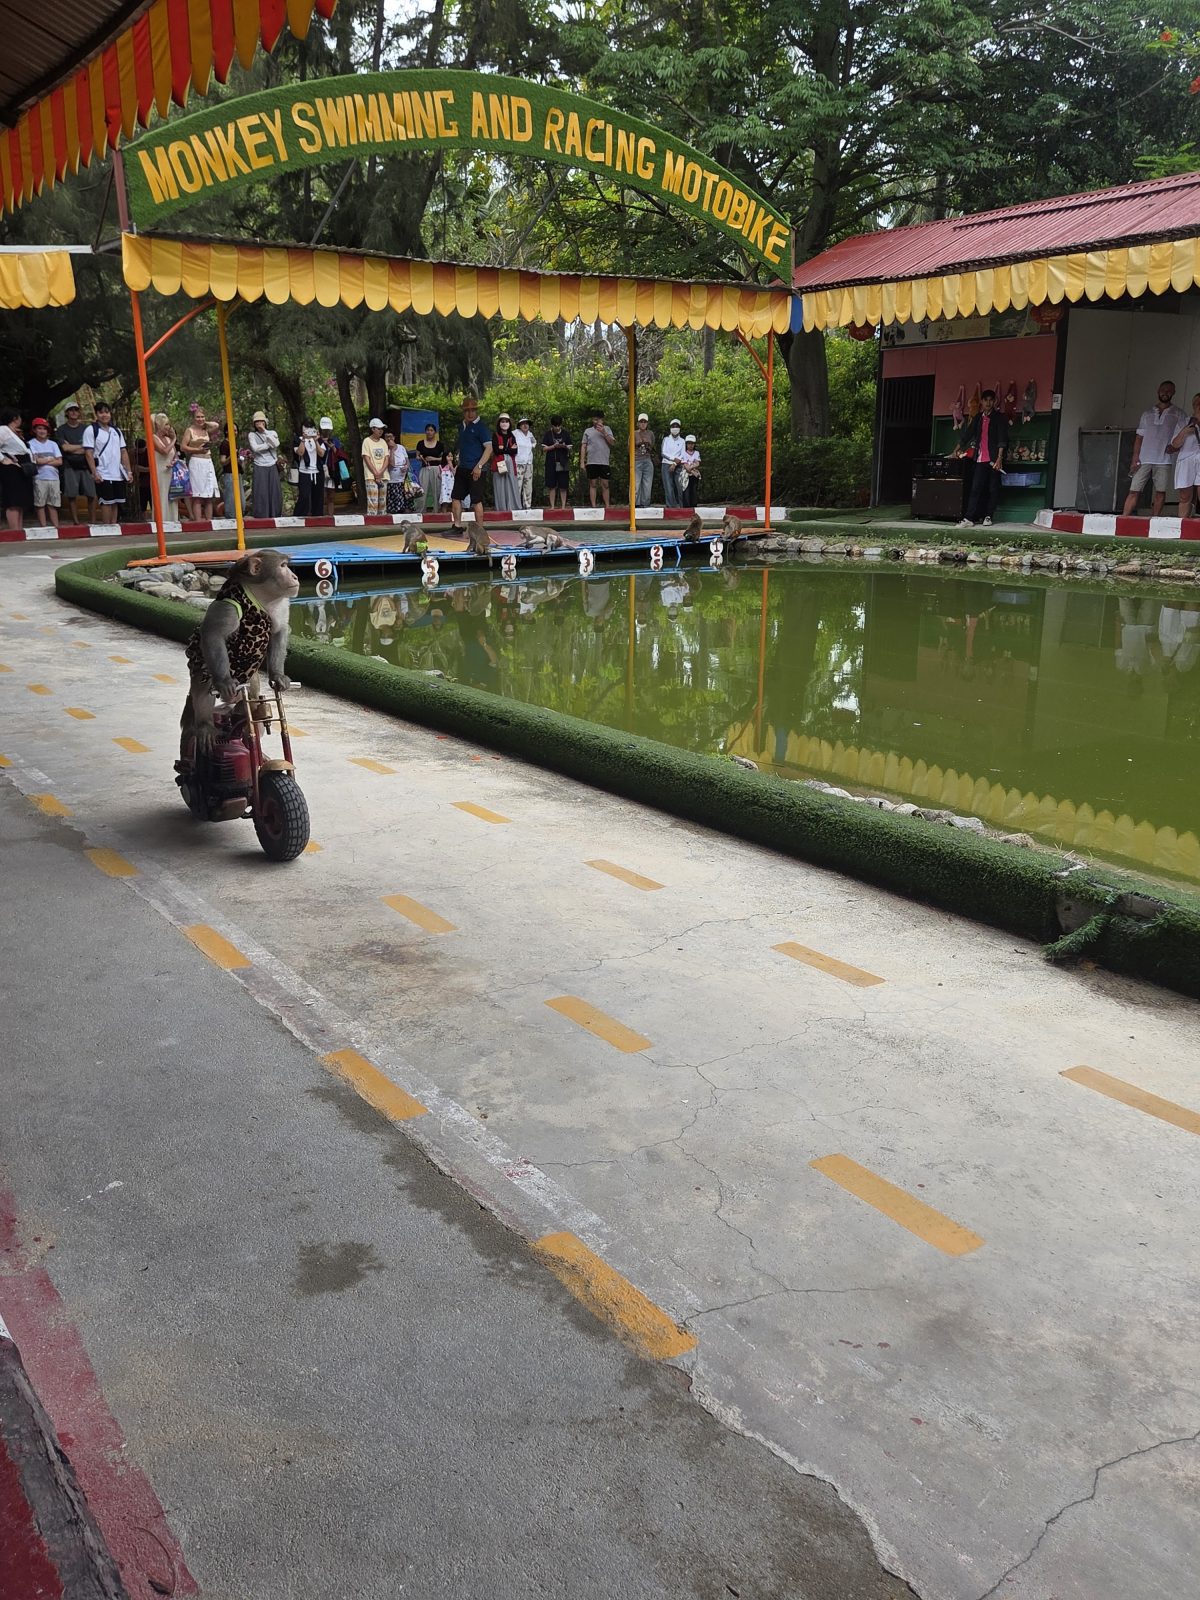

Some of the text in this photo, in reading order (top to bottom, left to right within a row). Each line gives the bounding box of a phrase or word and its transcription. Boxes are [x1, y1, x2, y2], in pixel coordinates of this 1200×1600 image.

[138, 90, 790, 264] MONKEY SWIMMING AND RACING MOTOBIKE
[653, 545, 661, 557] 2
[317, 561, 330, 577] 6
[503, 554, 515, 570] 4
